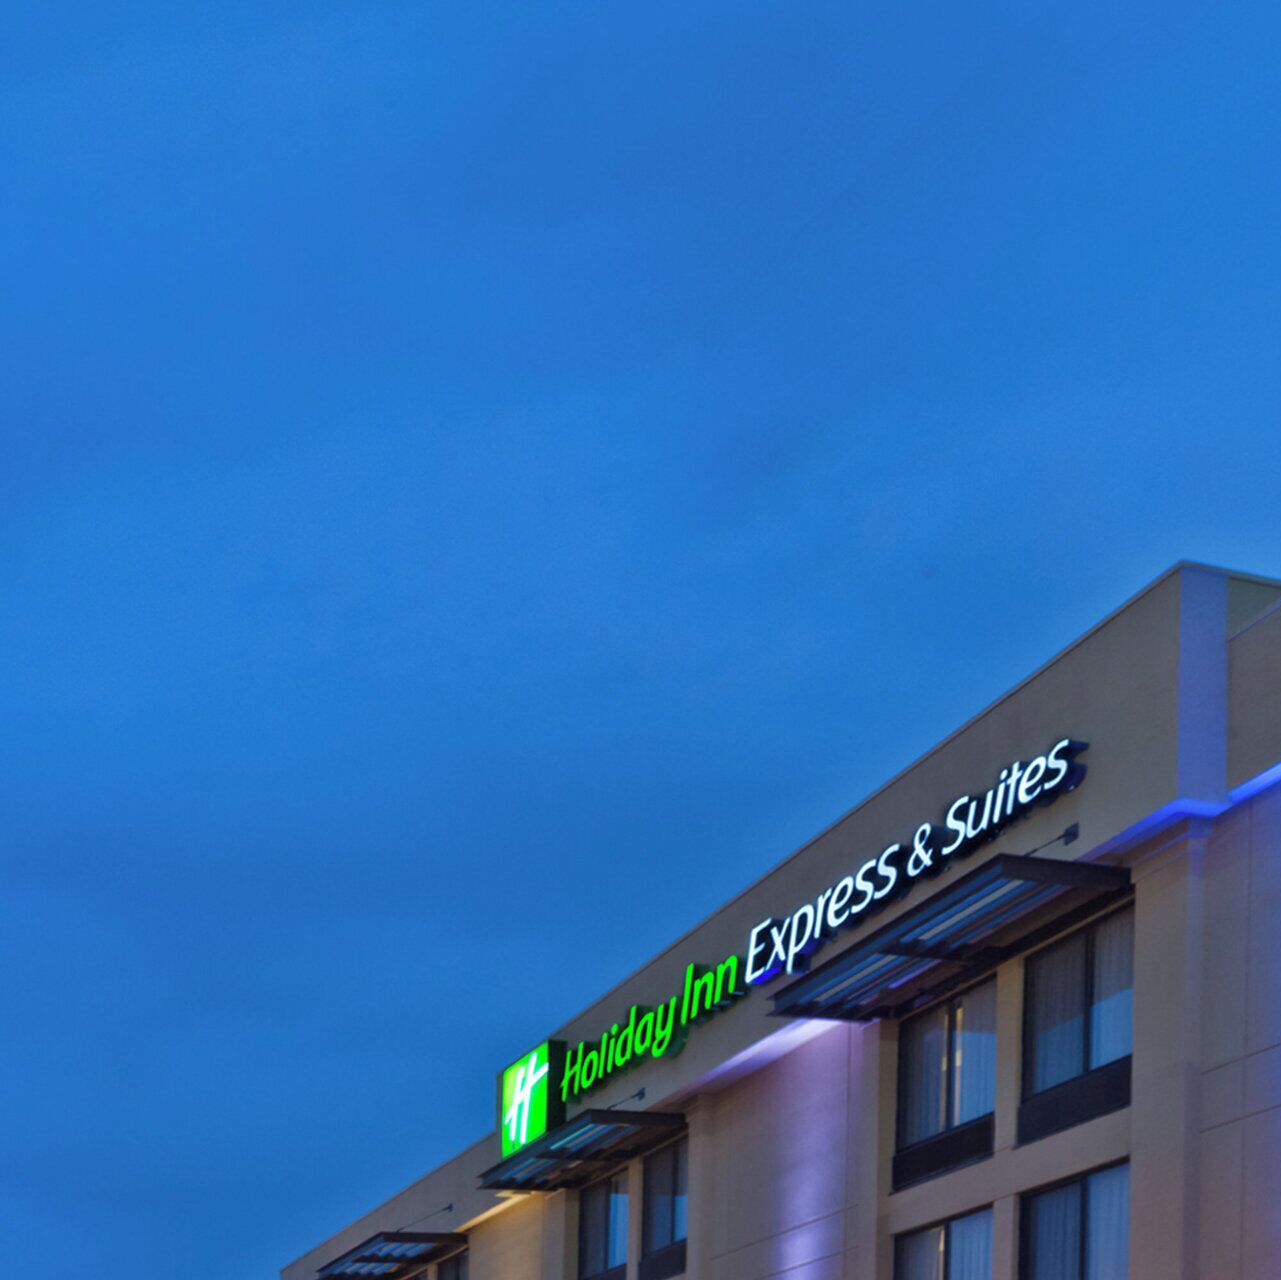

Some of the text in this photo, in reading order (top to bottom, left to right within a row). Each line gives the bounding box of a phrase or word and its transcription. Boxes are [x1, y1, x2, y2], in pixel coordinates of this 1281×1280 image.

[560, 738, 1070, 1102] Holiday Inn Express & Suites
